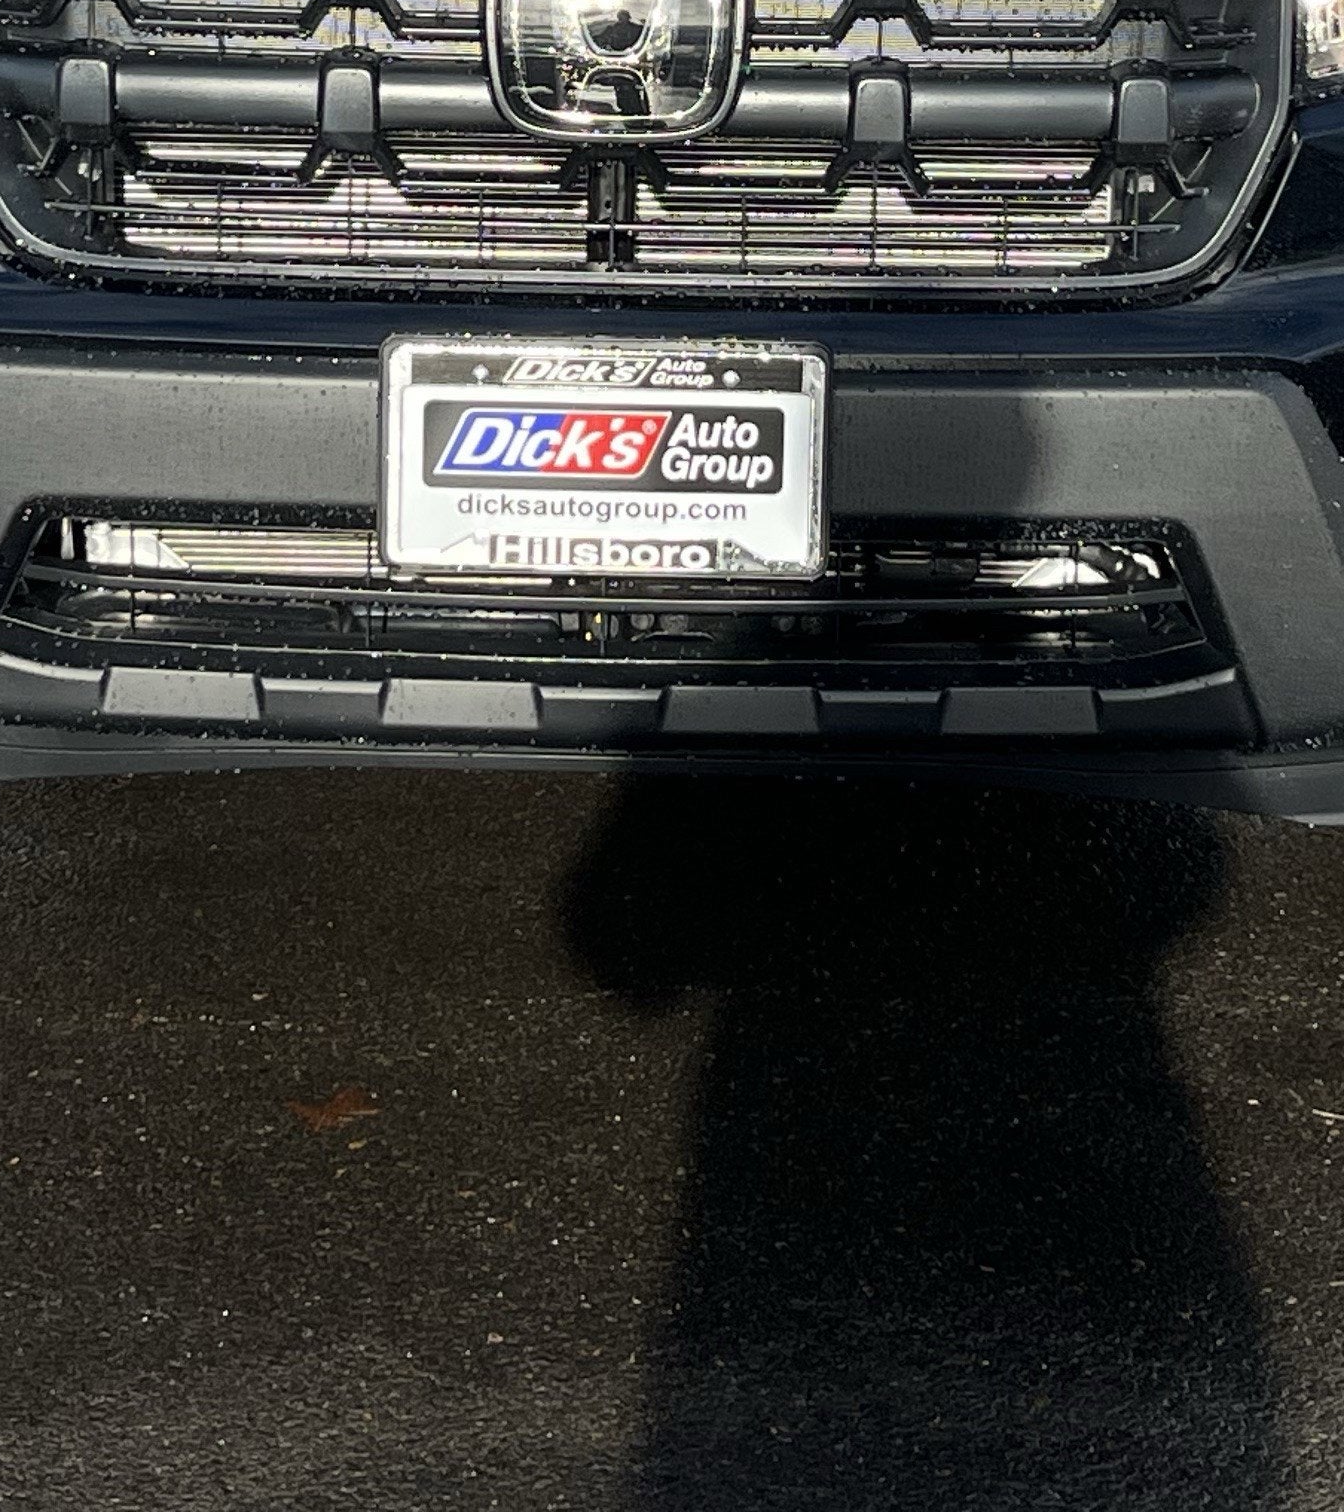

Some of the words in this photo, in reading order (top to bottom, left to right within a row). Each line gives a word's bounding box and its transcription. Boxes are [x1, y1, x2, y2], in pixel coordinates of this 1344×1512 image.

[513, 360, 636, 382] Dick's
[650, 372, 714, 387] Group
[656, 358, 706, 372] Auto
[452, 416, 644, 469] Dick's
[668, 414, 758, 449] Auto
[661, 449, 774, 488] Group
[457, 493, 747, 522] dicksautogroup.com
[495, 535, 712, 569] Hillsboro
